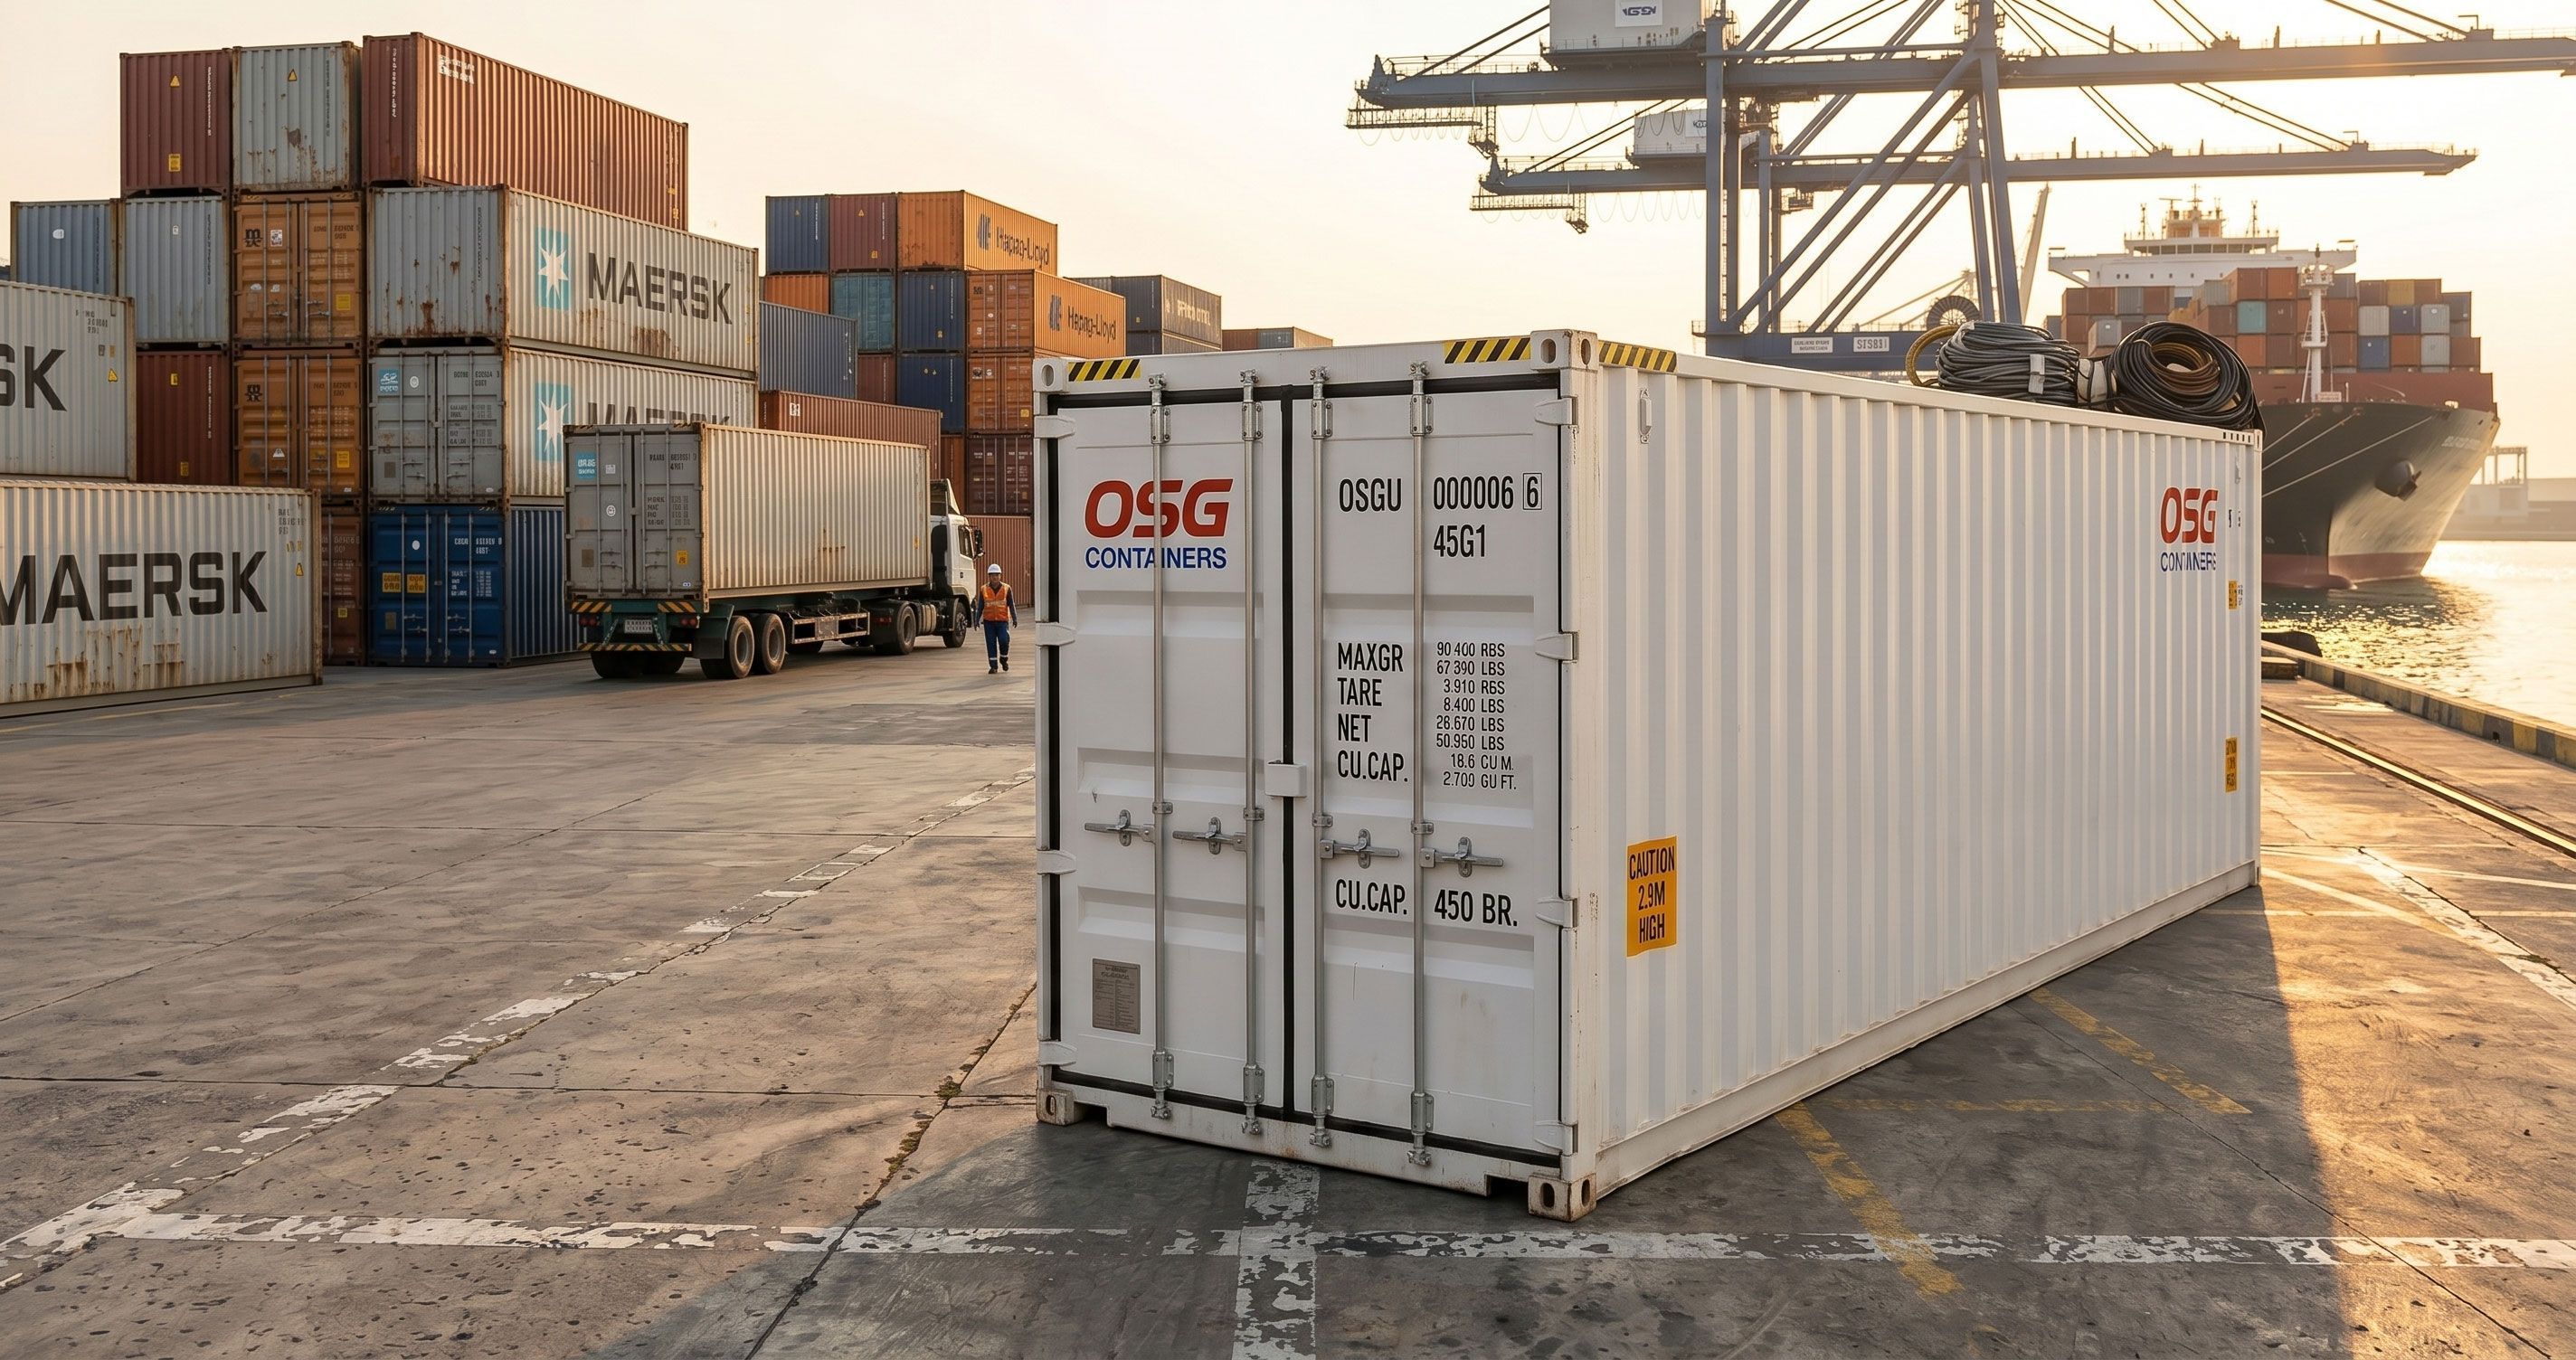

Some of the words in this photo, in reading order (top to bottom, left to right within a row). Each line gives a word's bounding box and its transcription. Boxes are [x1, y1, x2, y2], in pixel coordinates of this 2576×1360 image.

[588, 252, 733, 326] MAERSK
[1084, 479, 1234, 539] OSG
[1339, 477, 1402, 512] OSGU
[1433, 476, 1514, 510] 000006
[1526, 476, 1539, 508] 6
[2160, 486, 2219, 544] OSG
[1433, 524, 1486, 558] 45G1
[1085, 546, 1228, 570] CONTAINERS
[0, 551, 268, 626] MAERSK
[1337, 642, 1404, 673] MAXGR
[1481, 643, 1505, 658] RBS
[1482, 661, 1505, 676] LBS
[1337, 676, 1383, 707] TARE
[1444, 678, 1475, 694] 3.910
[1444, 696, 1475, 713] 8.400
[1481, 698, 1505, 713] LBS
[1338, 713, 1372, 742] NET
[1481, 717, 1505, 732] LBS
[1482, 735, 1505, 751] LBS
[1337, 750, 1409, 783] CU.CAP.
[1451, 753, 1475, 769] 18.6
[1501, 774, 1517, 790] FT.
[1629, 845, 1675, 881] CAUTION
[1335, 878, 1408, 915] CU.CAP.
[1434, 889, 1473, 922] 450
[1482, 892, 1518, 927] BR.
[1638, 880, 1665, 911] 2.9M
[1639, 912, 1665, 944] HIGH
